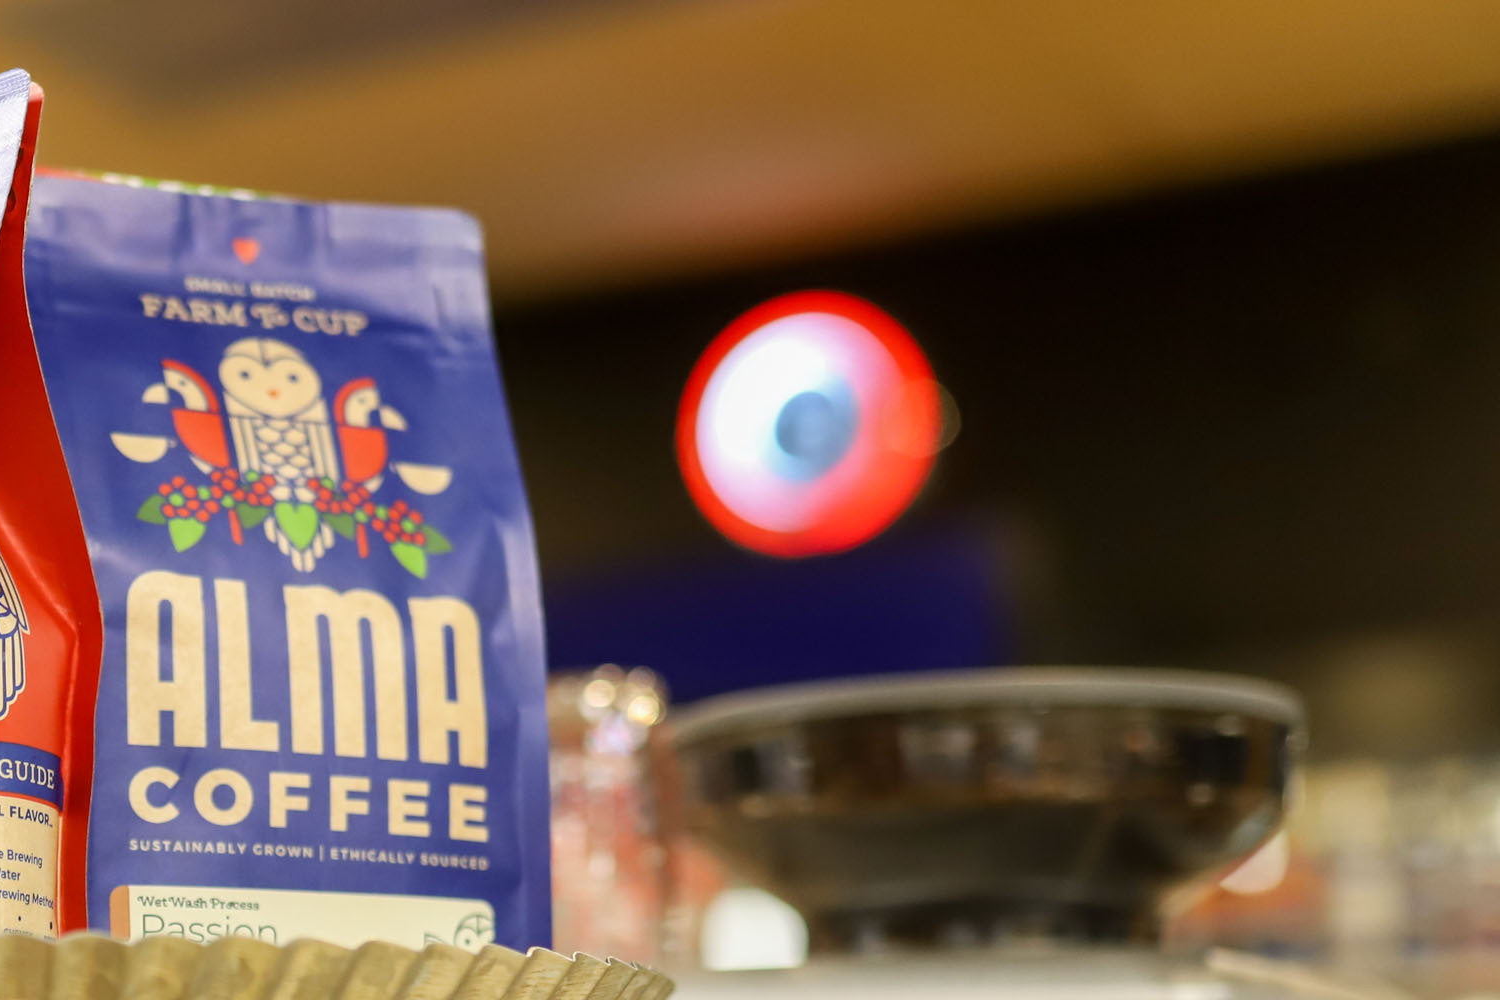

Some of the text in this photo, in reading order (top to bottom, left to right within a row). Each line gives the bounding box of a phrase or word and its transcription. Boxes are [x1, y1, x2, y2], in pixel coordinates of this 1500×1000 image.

[140, 293, 369, 336] FARM To CUP
[126, 570, 488, 769] ALMA
[128, 766, 489, 843] COFFEE
[7, 850, 43, 868] Brewing
[129, 839, 490, 871] SUSTAINABLY GROWN ETHICALLY SOURCED
[210, 898, 259, 910] Process
[142, 914, 277, 944] Passion
